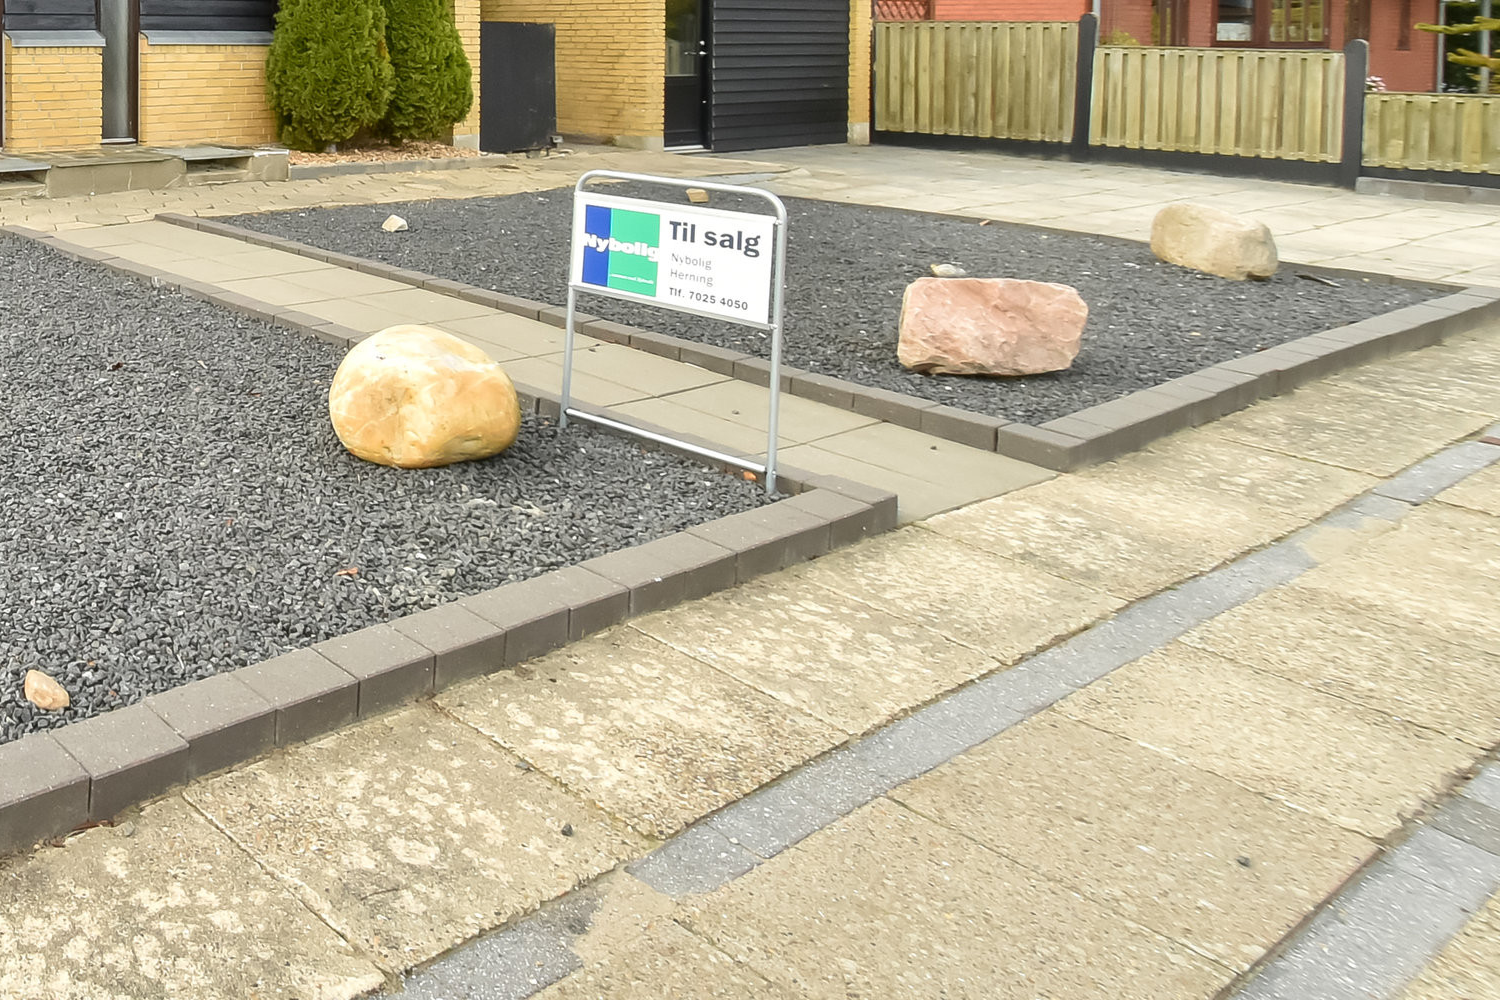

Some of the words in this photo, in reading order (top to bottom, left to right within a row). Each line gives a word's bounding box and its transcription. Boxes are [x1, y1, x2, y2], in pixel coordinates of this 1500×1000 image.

[584, 232, 659, 263] Nybolig
[669, 220, 696, 243] Til
[704, 230, 761, 258] salg
[671, 252, 712, 271] Nybolig
[670, 268, 713, 287] Herning
[669, 287, 685, 298] Tlf.
[689, 291, 716, 304] 7025
[719, 297, 748, 310] 4050
